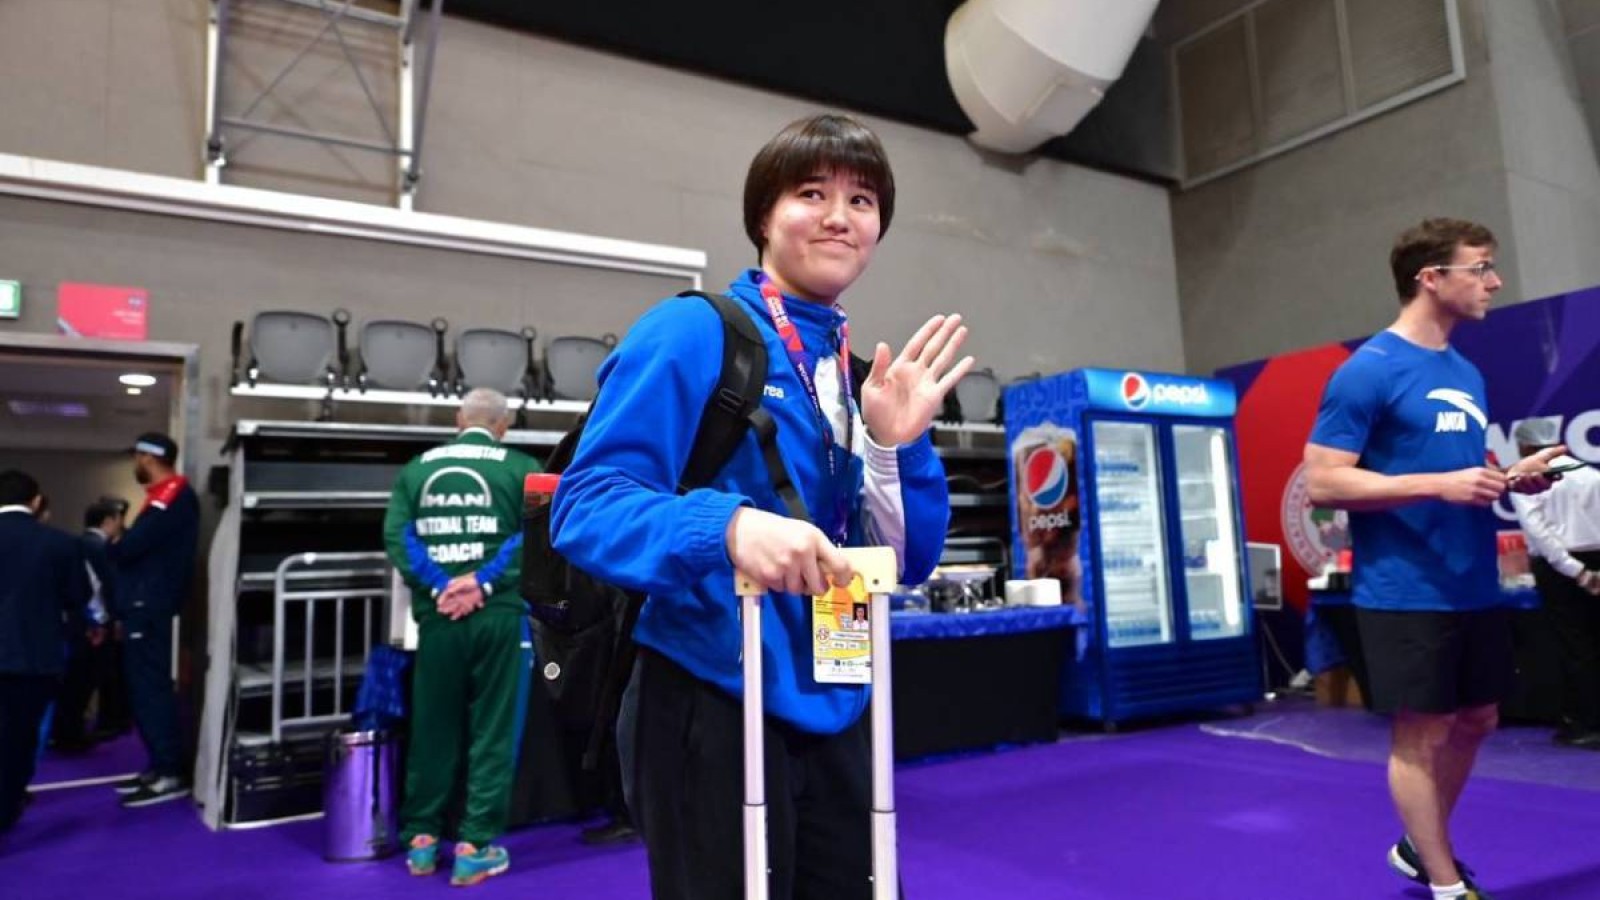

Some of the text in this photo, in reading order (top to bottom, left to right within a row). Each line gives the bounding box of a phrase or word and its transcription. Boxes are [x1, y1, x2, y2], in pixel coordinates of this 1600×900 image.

[1153, 382, 1210, 406] pepsi
[425, 493, 485, 507] MAN
[465, 515, 498, 533] TEAM
[1028, 512, 1072, 530] pepsi
[427, 542, 485, 563] COACH
